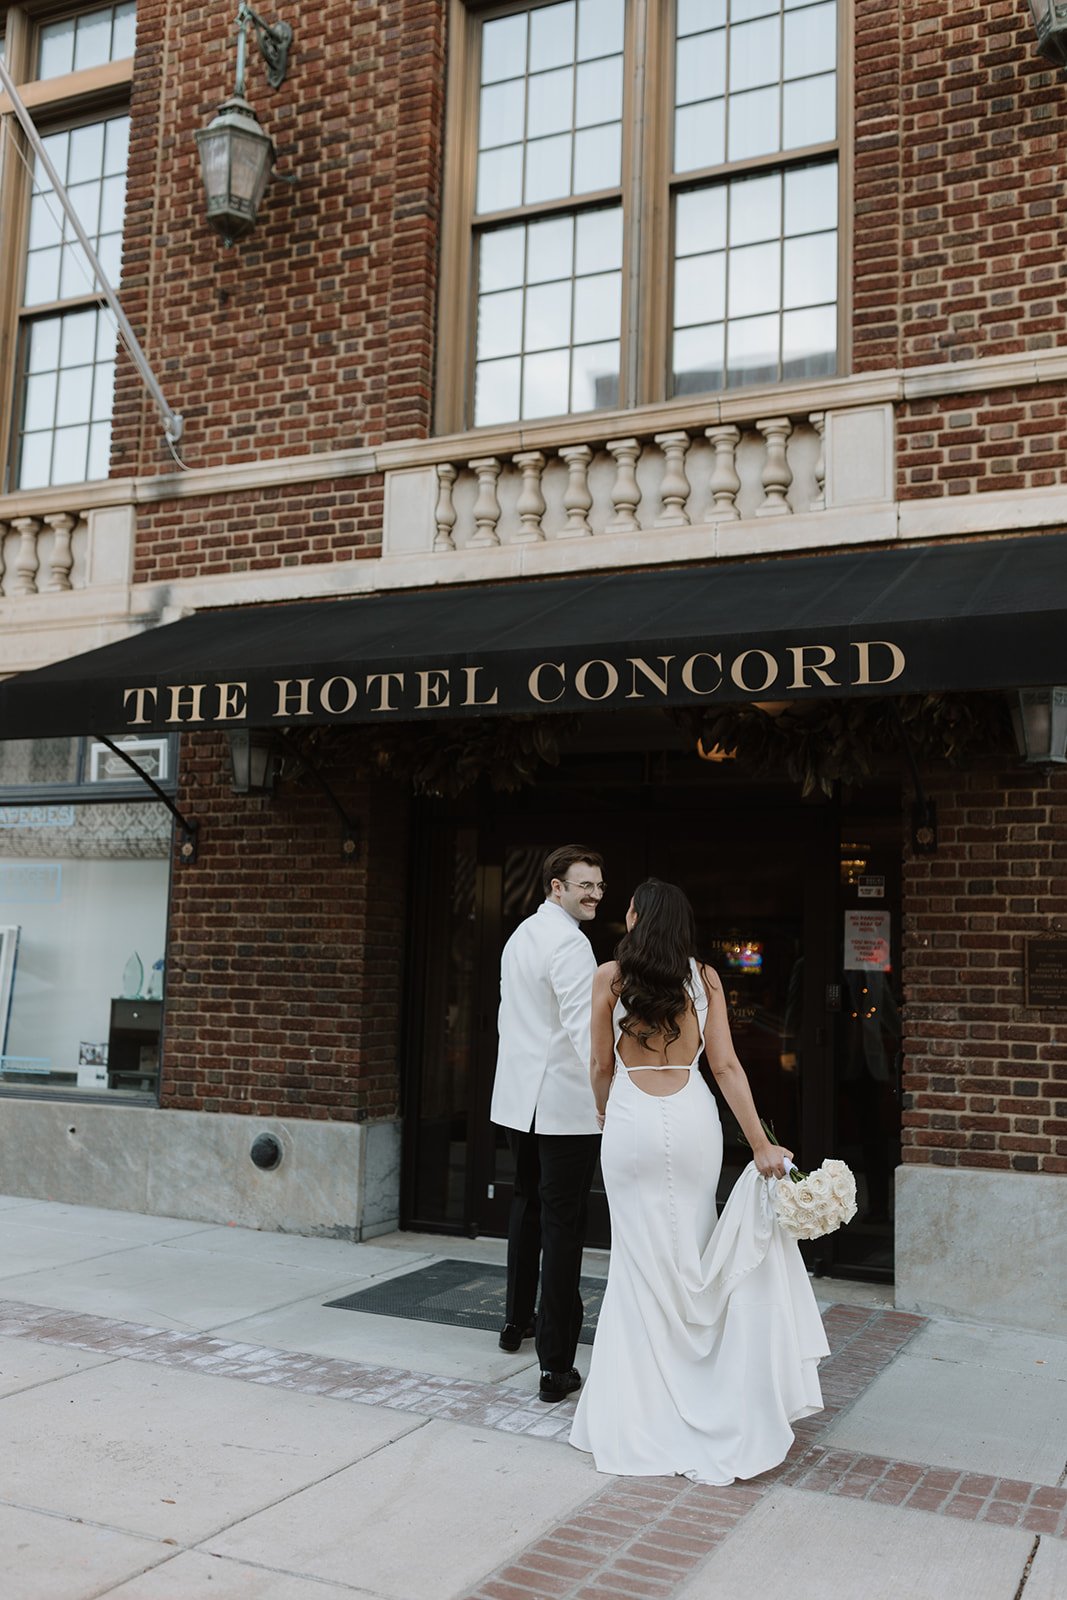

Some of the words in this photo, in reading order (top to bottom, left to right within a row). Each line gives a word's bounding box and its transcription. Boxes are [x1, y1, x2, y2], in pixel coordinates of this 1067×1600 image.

[123, 683, 247, 725] THE
[273, 666, 498, 717] HOTEL
[528, 641, 906, 704] CONCORD
[732, 1007, 758, 1017] VIEW
